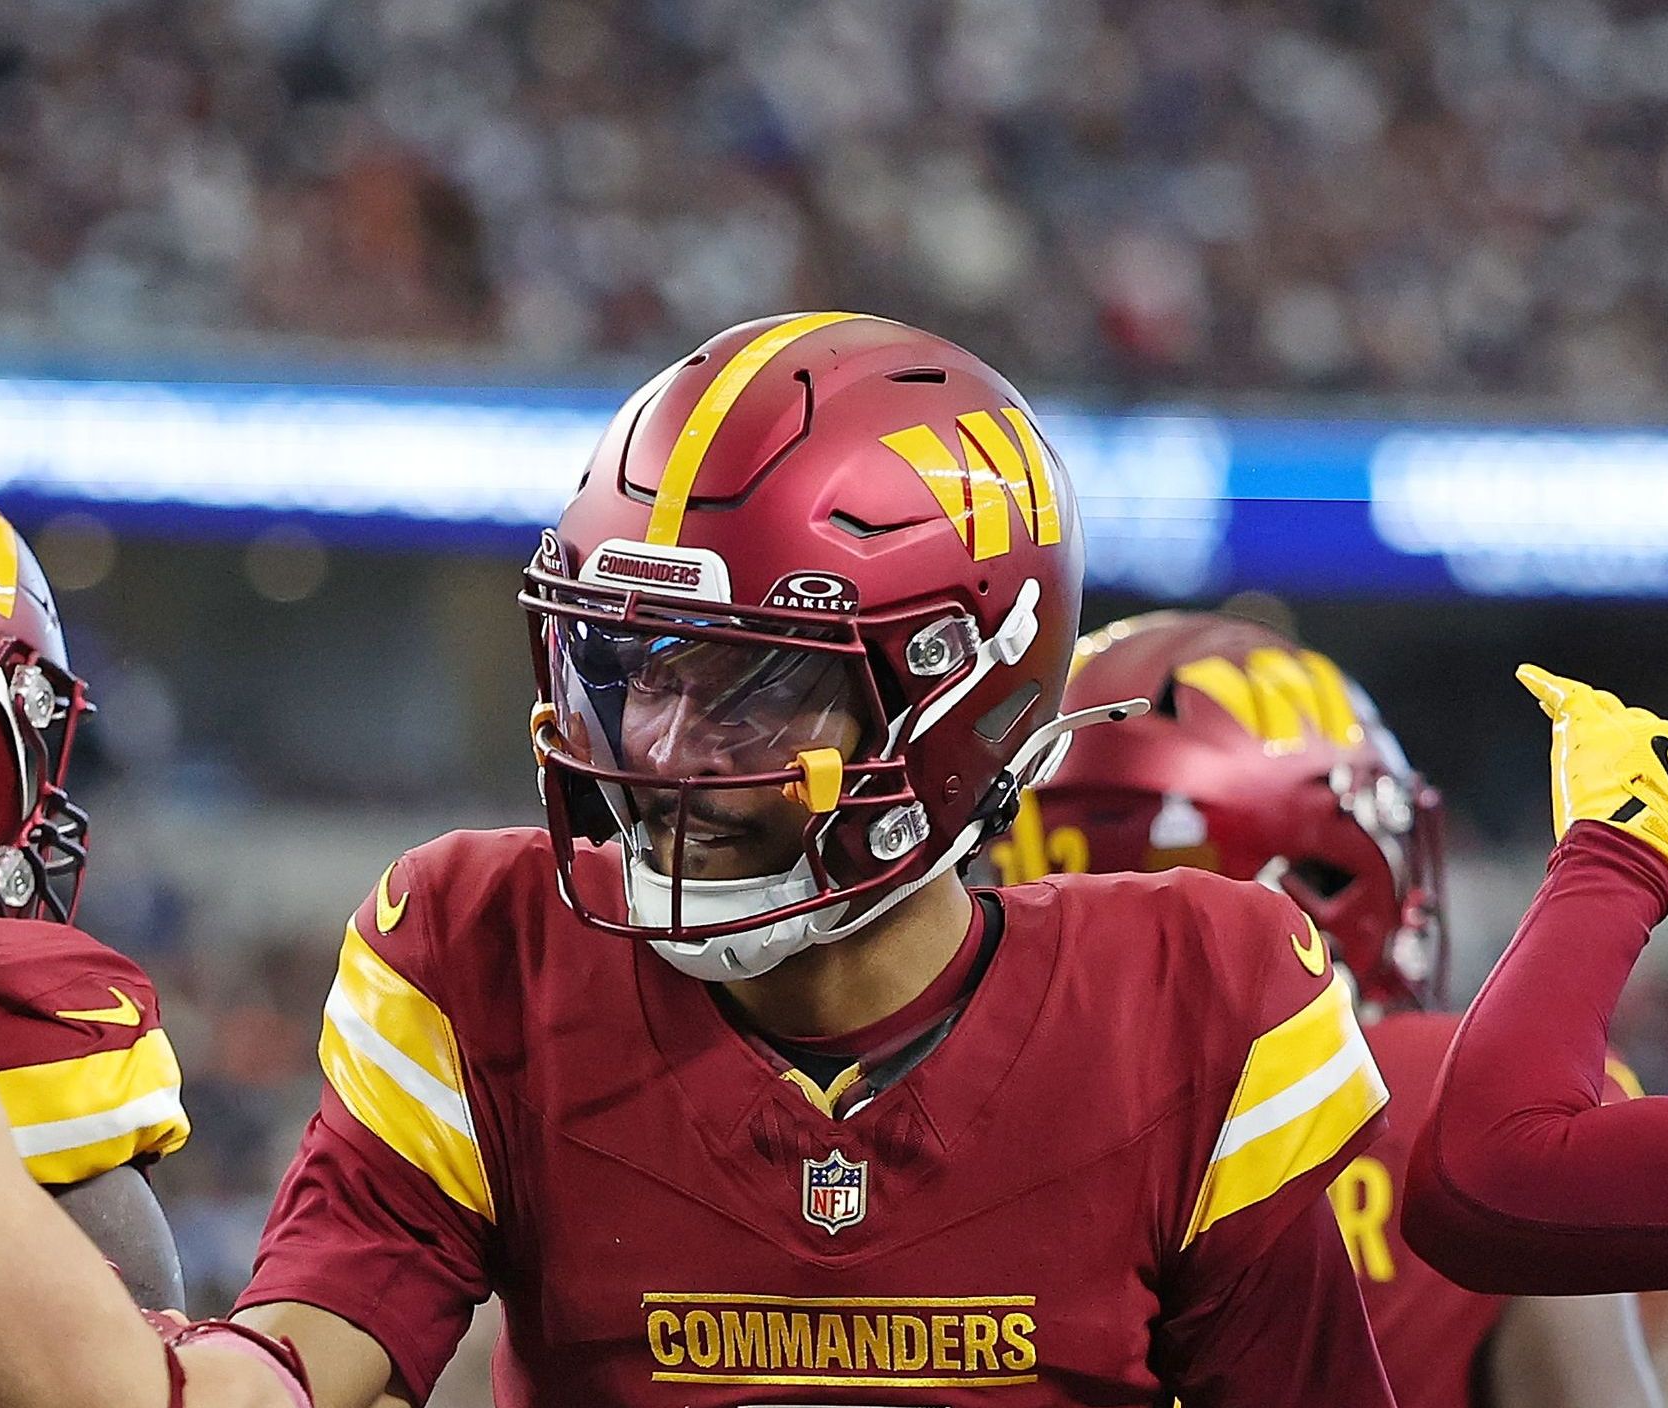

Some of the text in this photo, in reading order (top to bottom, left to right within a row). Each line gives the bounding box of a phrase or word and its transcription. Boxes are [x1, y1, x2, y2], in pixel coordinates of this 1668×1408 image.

[597, 552, 703, 587] COMMANDERS
[772, 594, 854, 611] OAKLEY
[812, 1189, 855, 1219] NFL
[646, 1308, 1037, 1372] COMMANDERS
